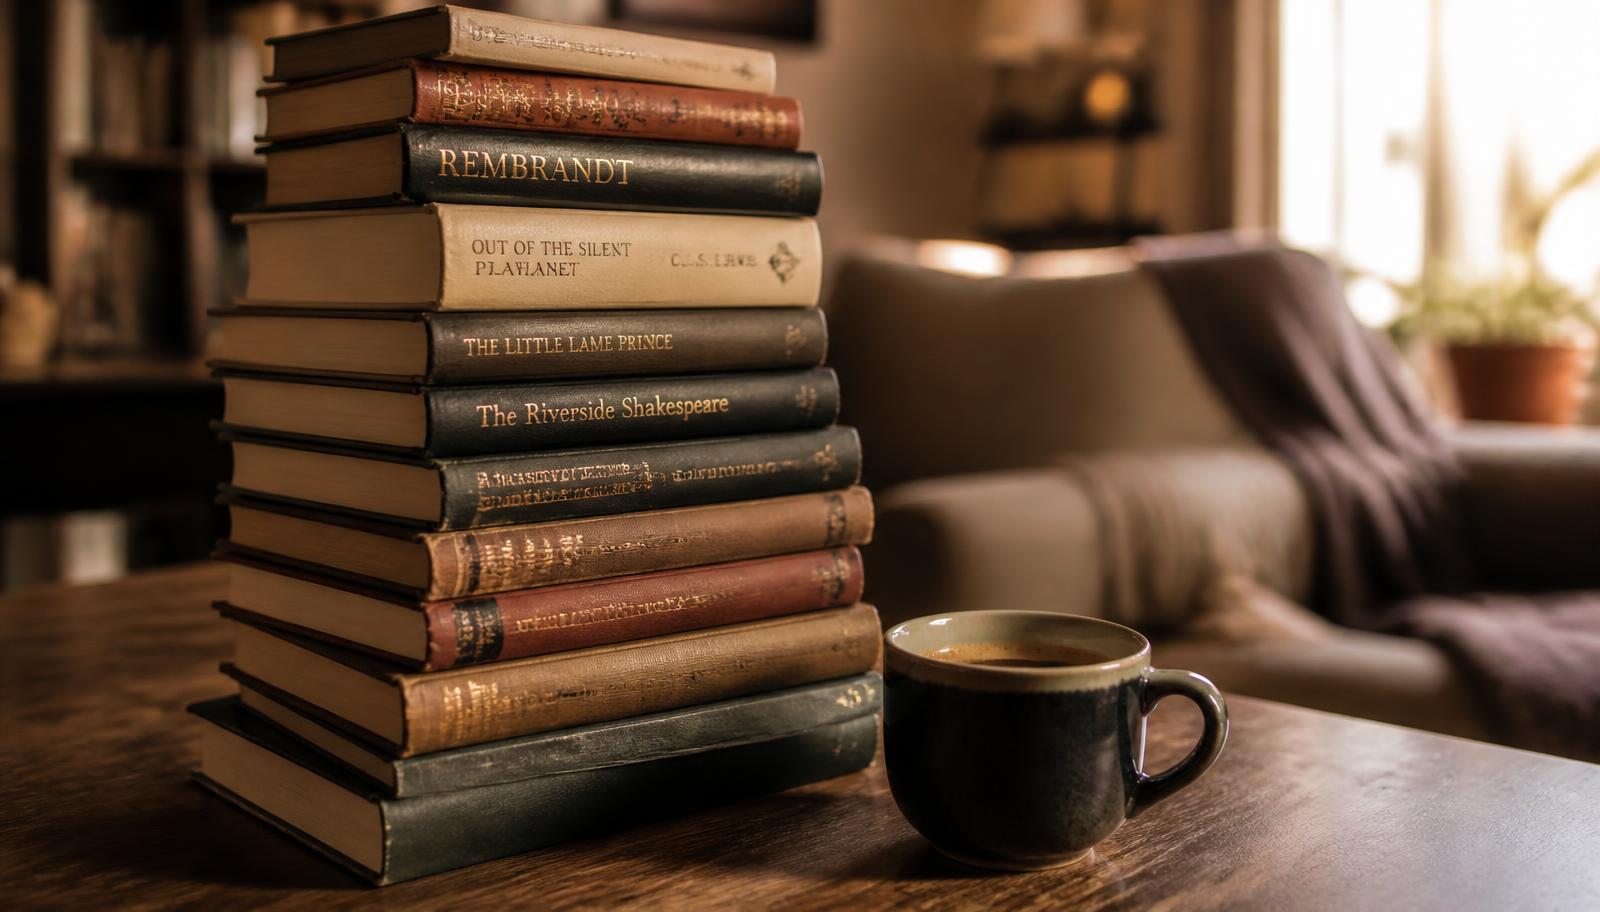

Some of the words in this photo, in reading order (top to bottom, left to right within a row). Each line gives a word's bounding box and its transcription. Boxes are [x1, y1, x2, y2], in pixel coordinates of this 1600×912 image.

[438, 149, 634, 185] REMBRANDT
[472, 239, 508, 255] OUT
[514, 240, 535, 256] OF
[541, 240, 573, 256] THE
[579, 242, 632, 257] SILENT
[463, 338, 500, 356] THE
[504, 336, 564, 355] LITTLE
[568, 335, 614, 353] LAME
[618, 333, 673, 350] PRINCE
[476, 404, 517, 428] The
[524, 398, 615, 425] Riverside
[622, 395, 729, 420] Shakespeare
